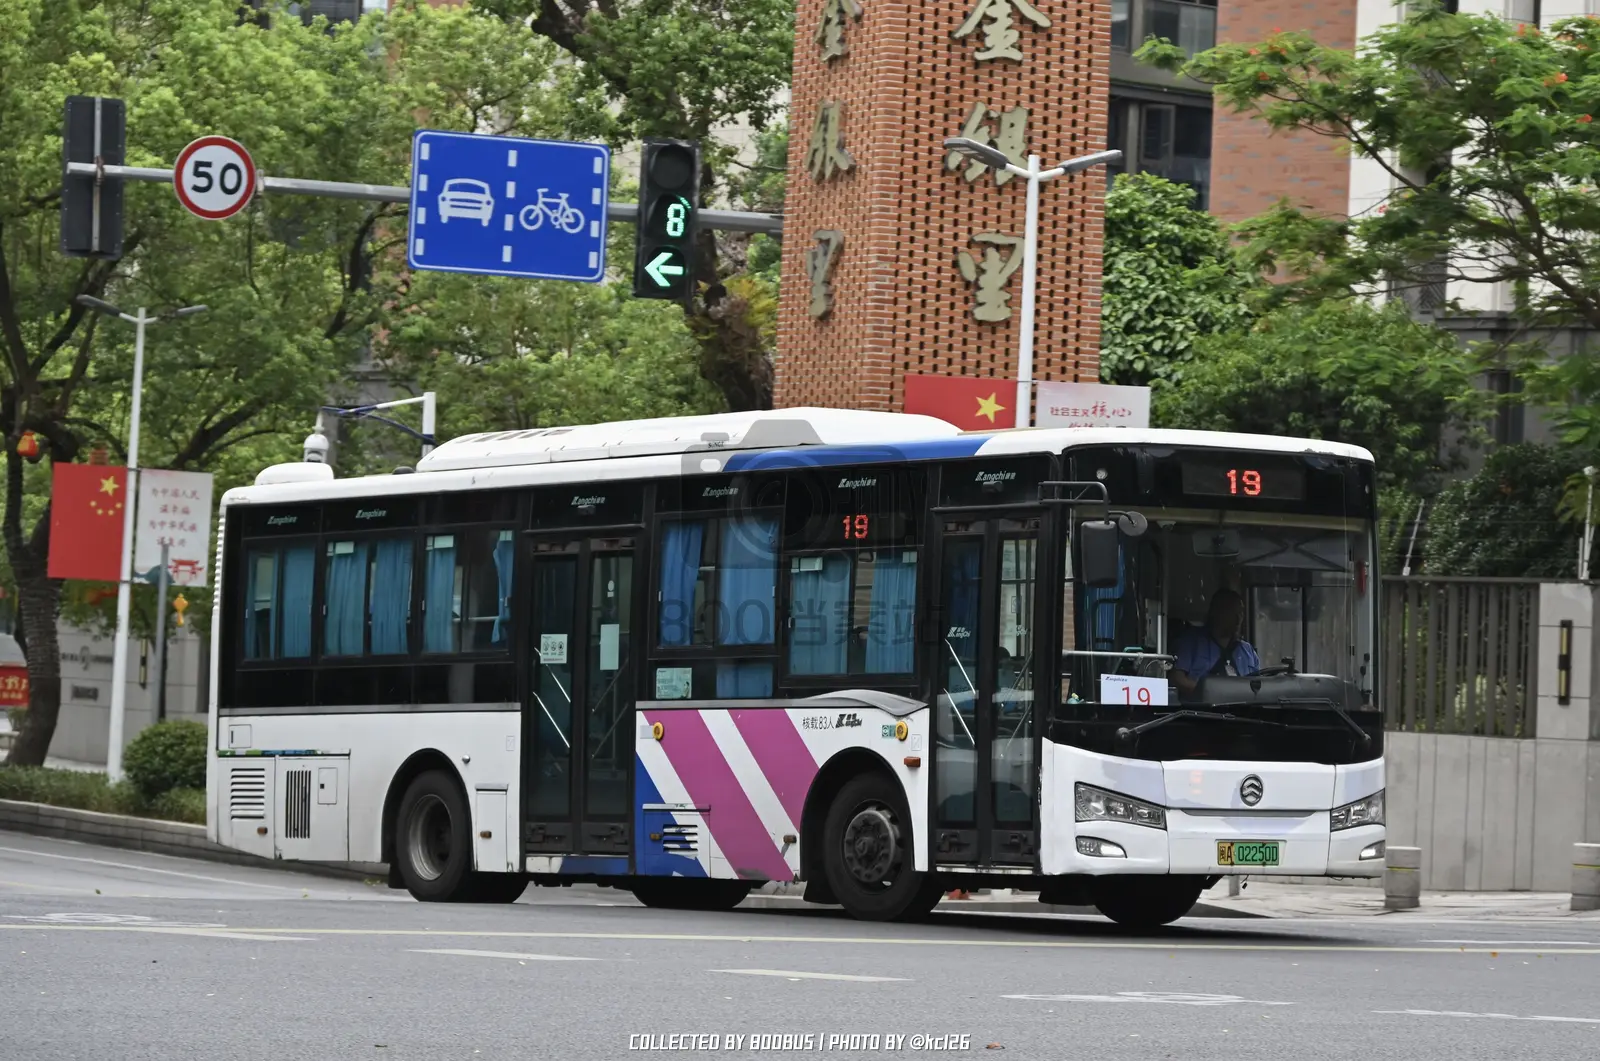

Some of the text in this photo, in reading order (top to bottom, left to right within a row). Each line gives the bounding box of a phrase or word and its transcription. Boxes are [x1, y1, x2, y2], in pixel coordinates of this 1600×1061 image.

[191, 161, 242, 195] 50
[666, 203, 685, 237] 8
[1226, 469, 1261, 496] 19
[842, 514, 868, 539] 19
[1121, 686, 1151, 707] 19
